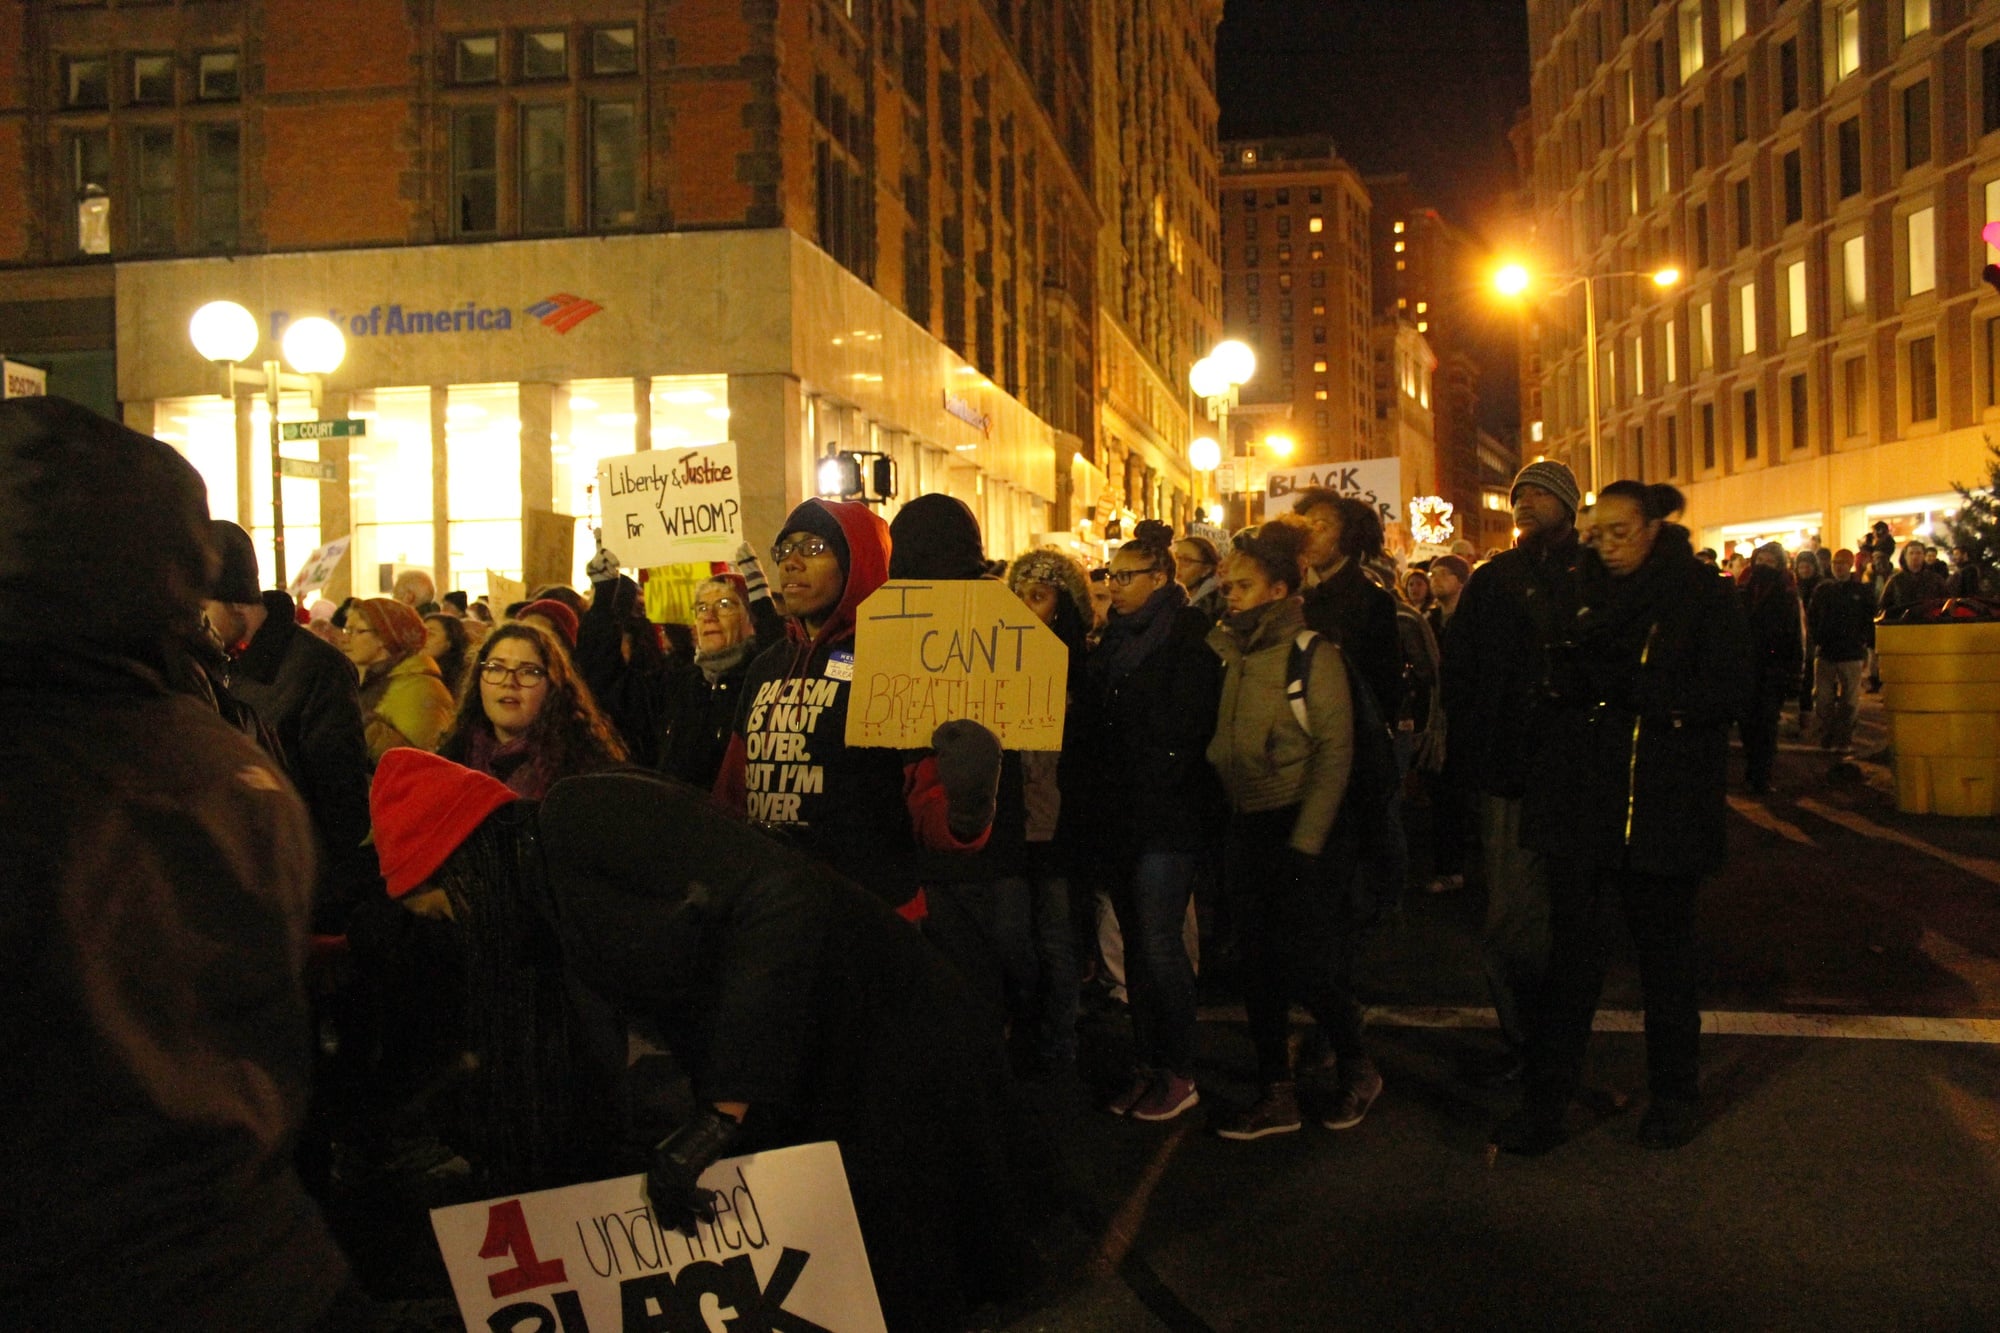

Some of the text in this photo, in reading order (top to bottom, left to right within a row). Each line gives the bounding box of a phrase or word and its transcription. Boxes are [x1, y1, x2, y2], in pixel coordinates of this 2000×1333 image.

[350, 305, 382, 336] of
[385, 302, 512, 336] America
[300, 422, 334, 438] COURT
[609, 451, 733, 509] Liberty & Justice
[1269, 468, 1361, 498] BLACK
[626, 499, 739, 539] For WHOM?
[648, 579, 697, 619] MATT
[869, 586, 933, 620] I
[920, 618, 1035, 673] CAN'T
[752, 678, 839, 707] RACISM
[747, 704, 823, 733] IS NOT
[747, 732, 811, 761] OVER.
[779, 764, 824, 793] I'M
[746, 792, 801, 821] OVER
[478, 1166, 769, 1298] 1 unaed
